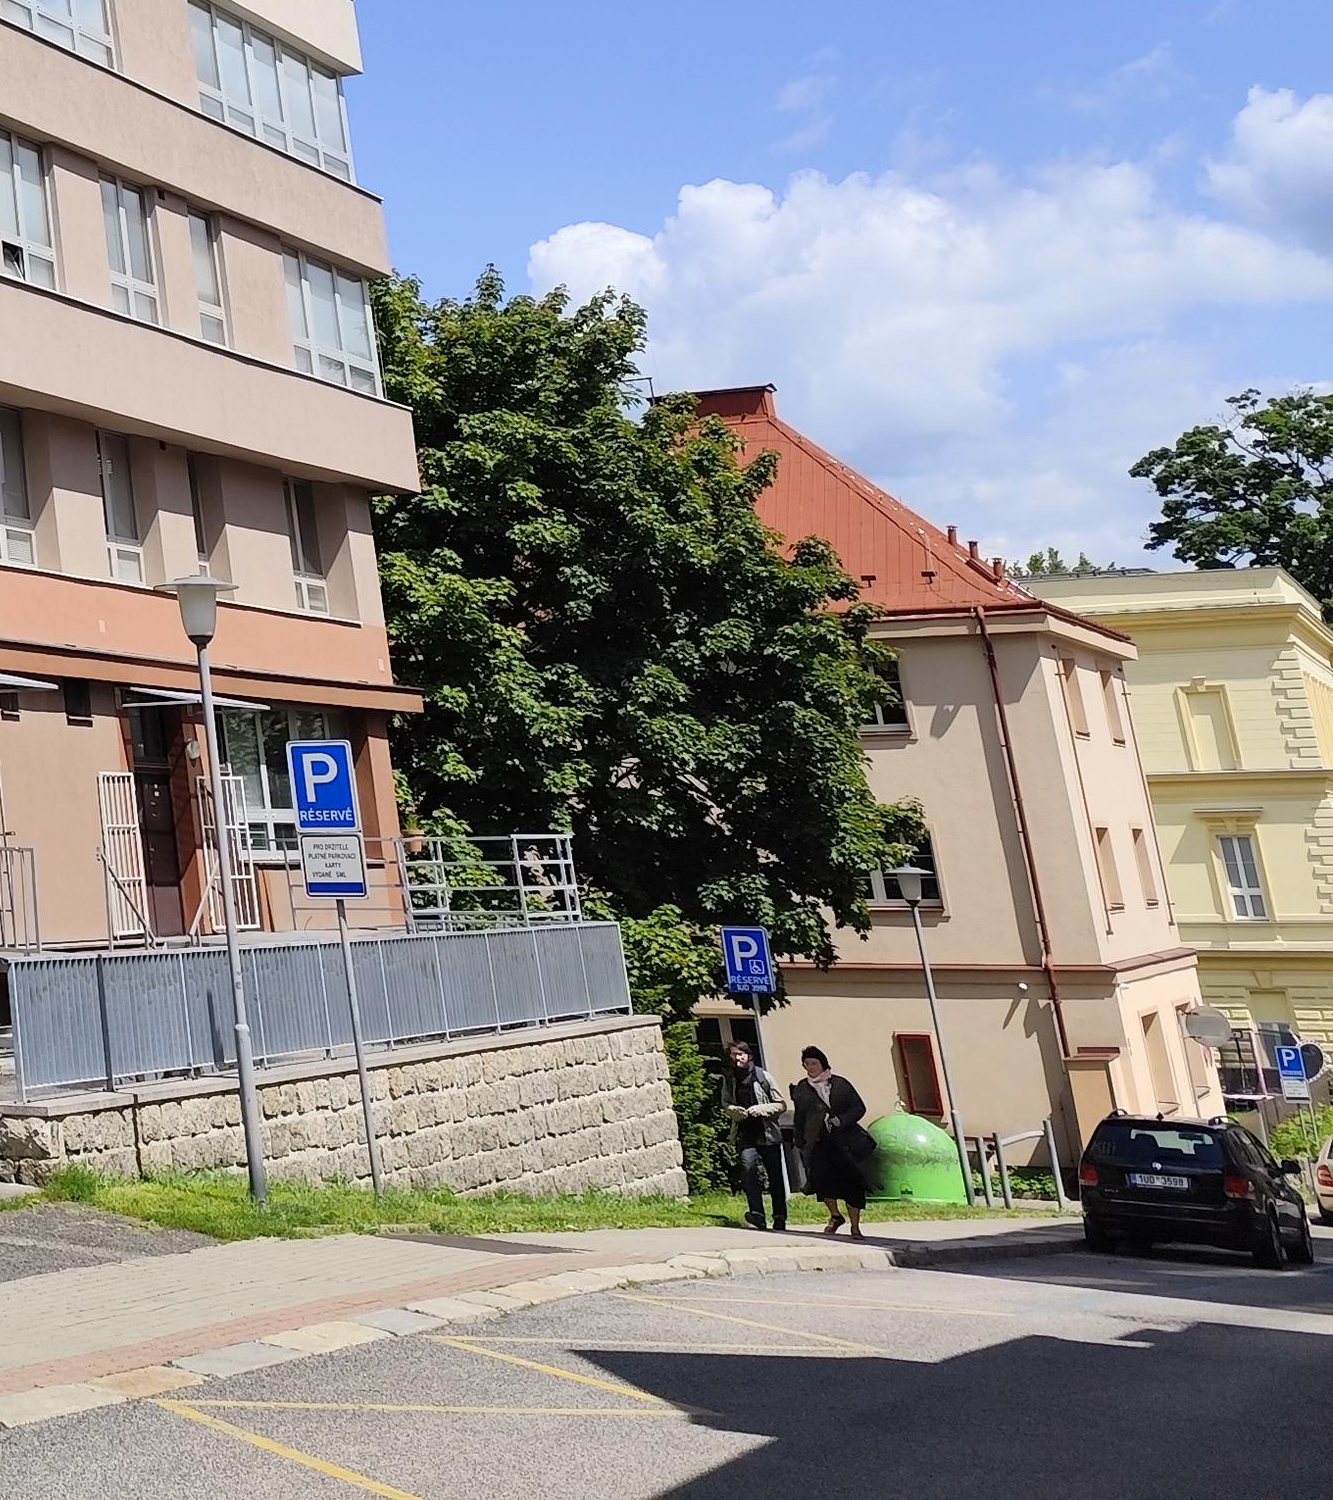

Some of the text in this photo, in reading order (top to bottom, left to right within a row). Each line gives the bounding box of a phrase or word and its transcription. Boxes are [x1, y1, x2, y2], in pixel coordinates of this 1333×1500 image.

[302, 753, 338, 803] P
[299, 807, 354, 822] RÉSERVÉ
[731, 935, 758, 971] P
[731, 974, 770, 984] RÉSERVÉ
[1281, 1049, 1295, 1067] P
